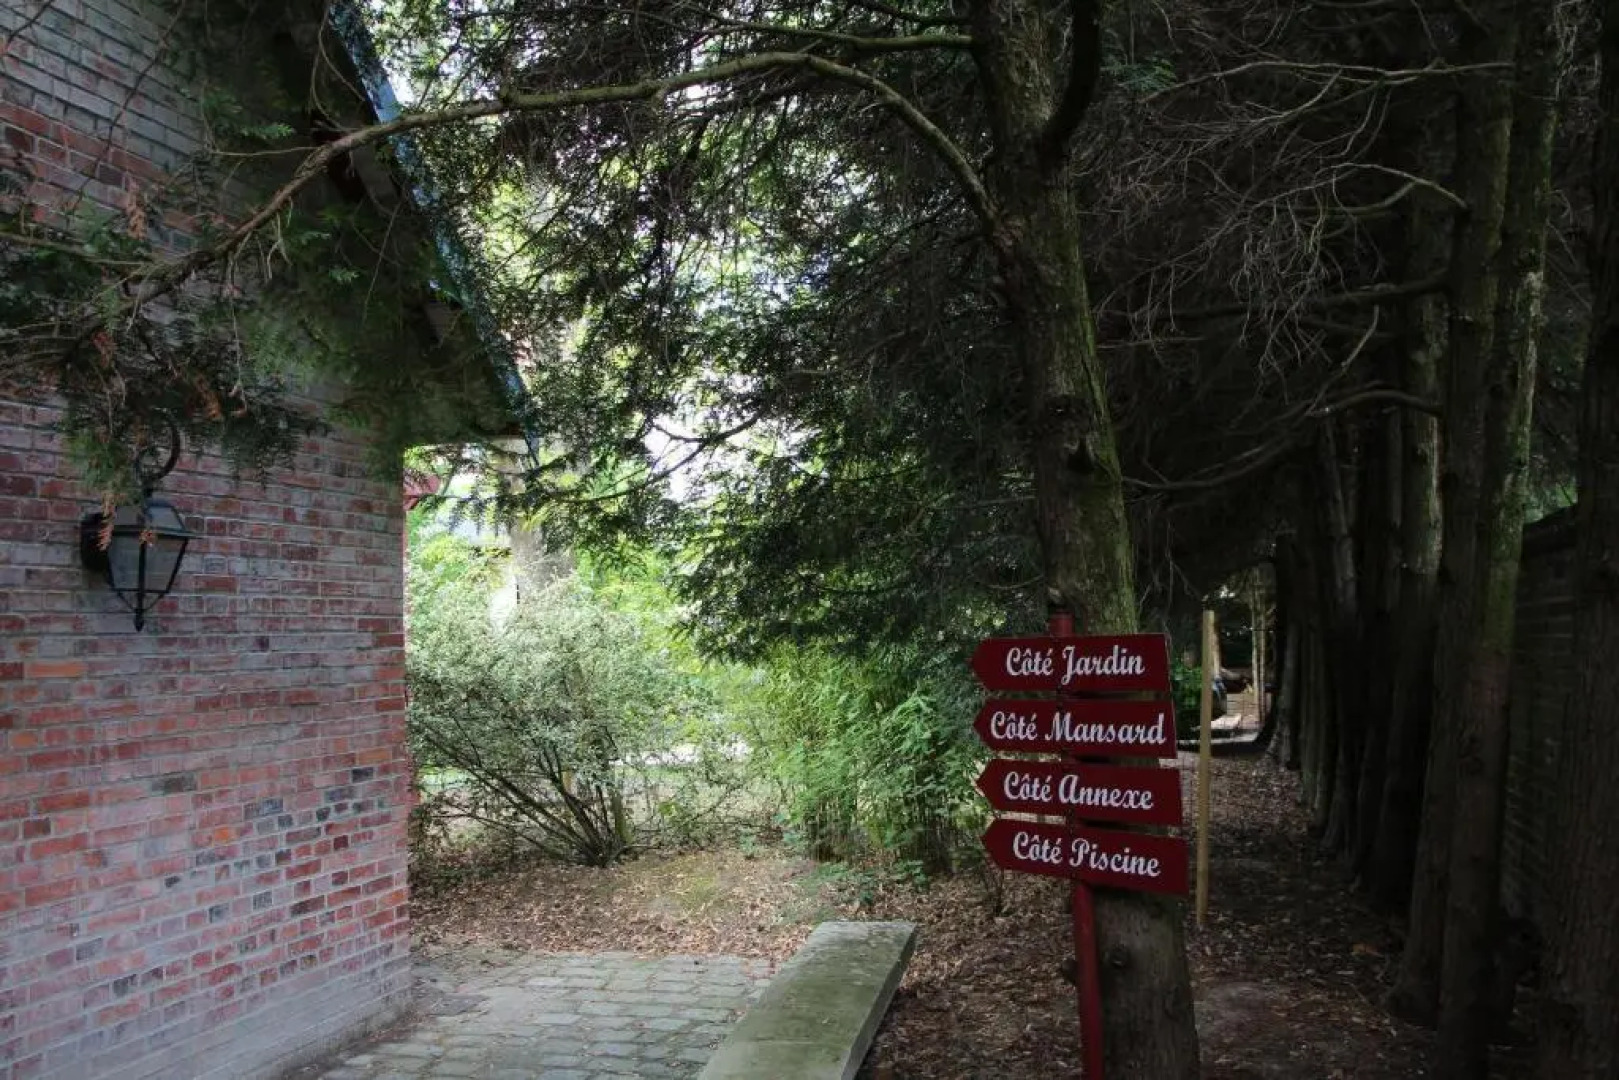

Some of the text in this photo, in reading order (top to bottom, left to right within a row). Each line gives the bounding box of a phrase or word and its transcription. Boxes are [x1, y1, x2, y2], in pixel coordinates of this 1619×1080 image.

[1005, 645, 1145, 685] Côté Jardin
[990, 711, 1166, 744] Côté Mansard
[1003, 771, 1154, 810] Côté Annexe
[1012, 831, 1161, 877] Côté Piscine
